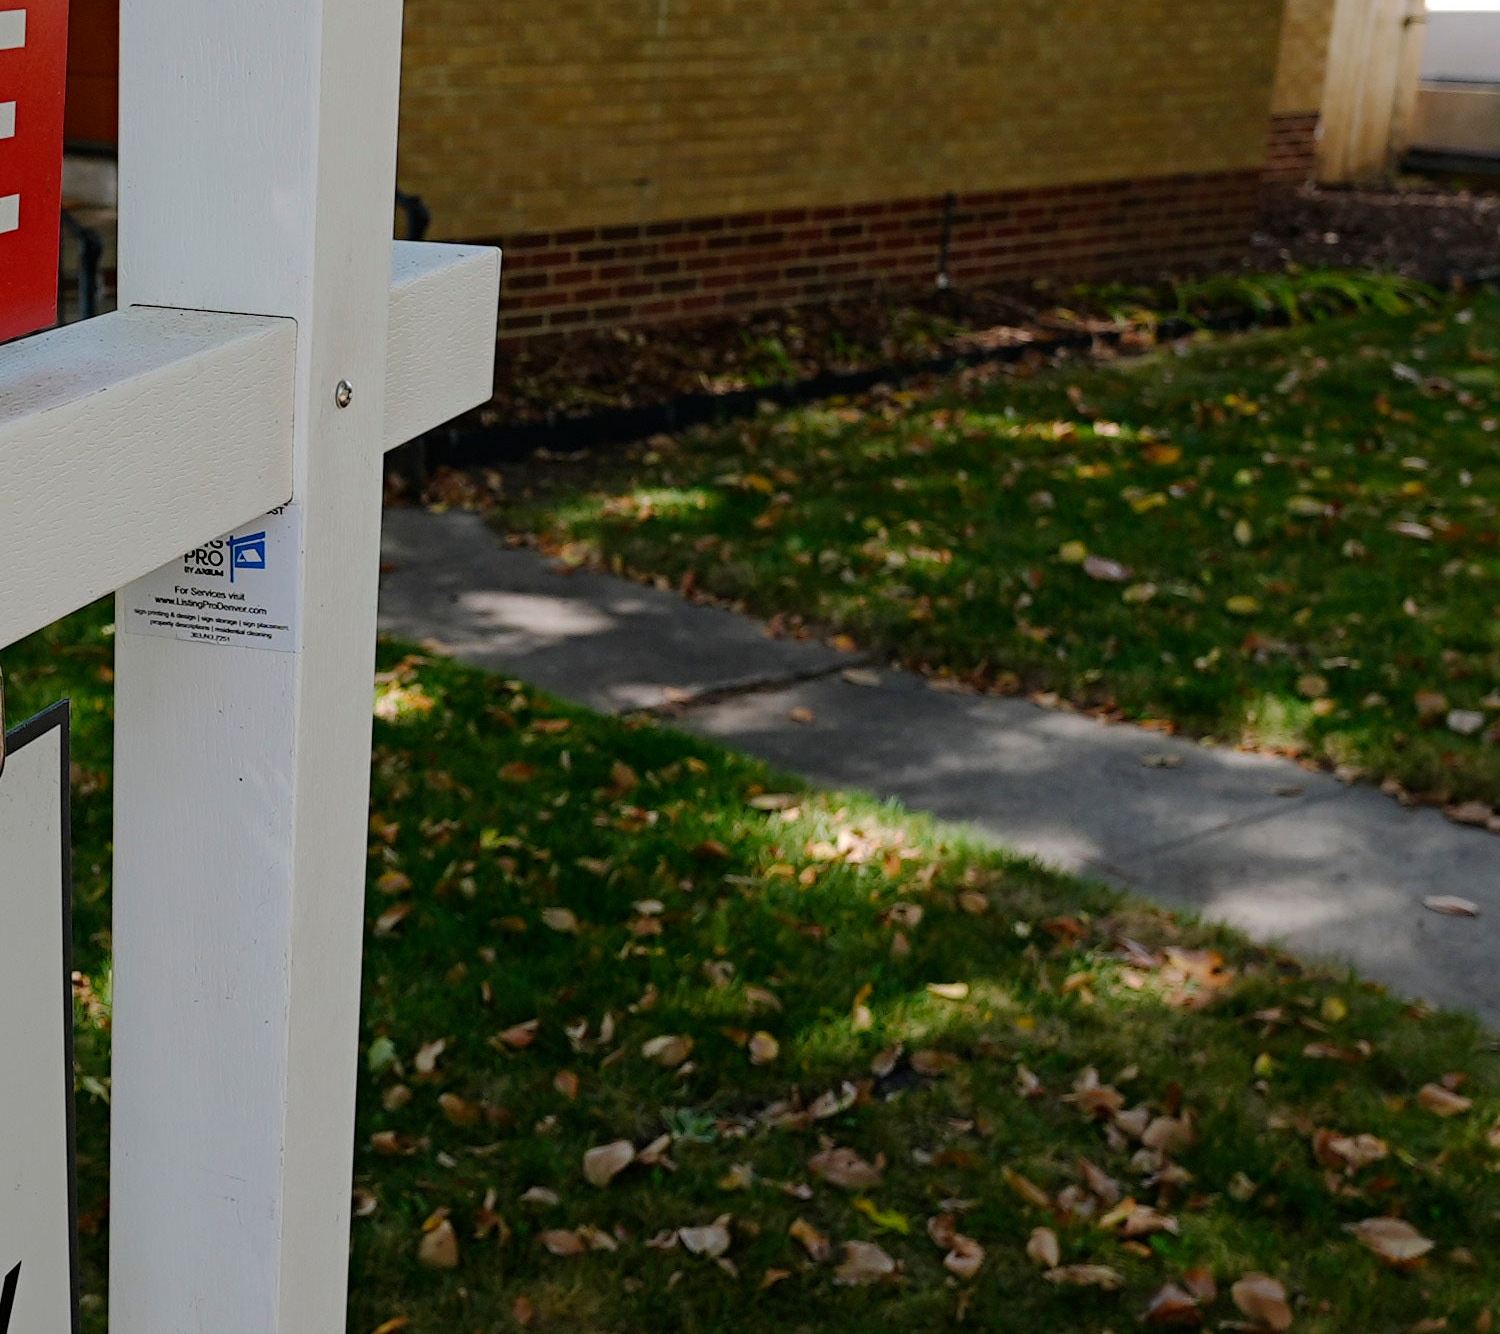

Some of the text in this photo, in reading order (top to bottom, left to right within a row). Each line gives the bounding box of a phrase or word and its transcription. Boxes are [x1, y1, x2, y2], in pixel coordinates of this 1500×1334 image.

[184, 548, 224, 567] PRO
[174, 585, 245, 601] For Services visit
[154, 596, 268, 616] www.ListingProDenver.com
